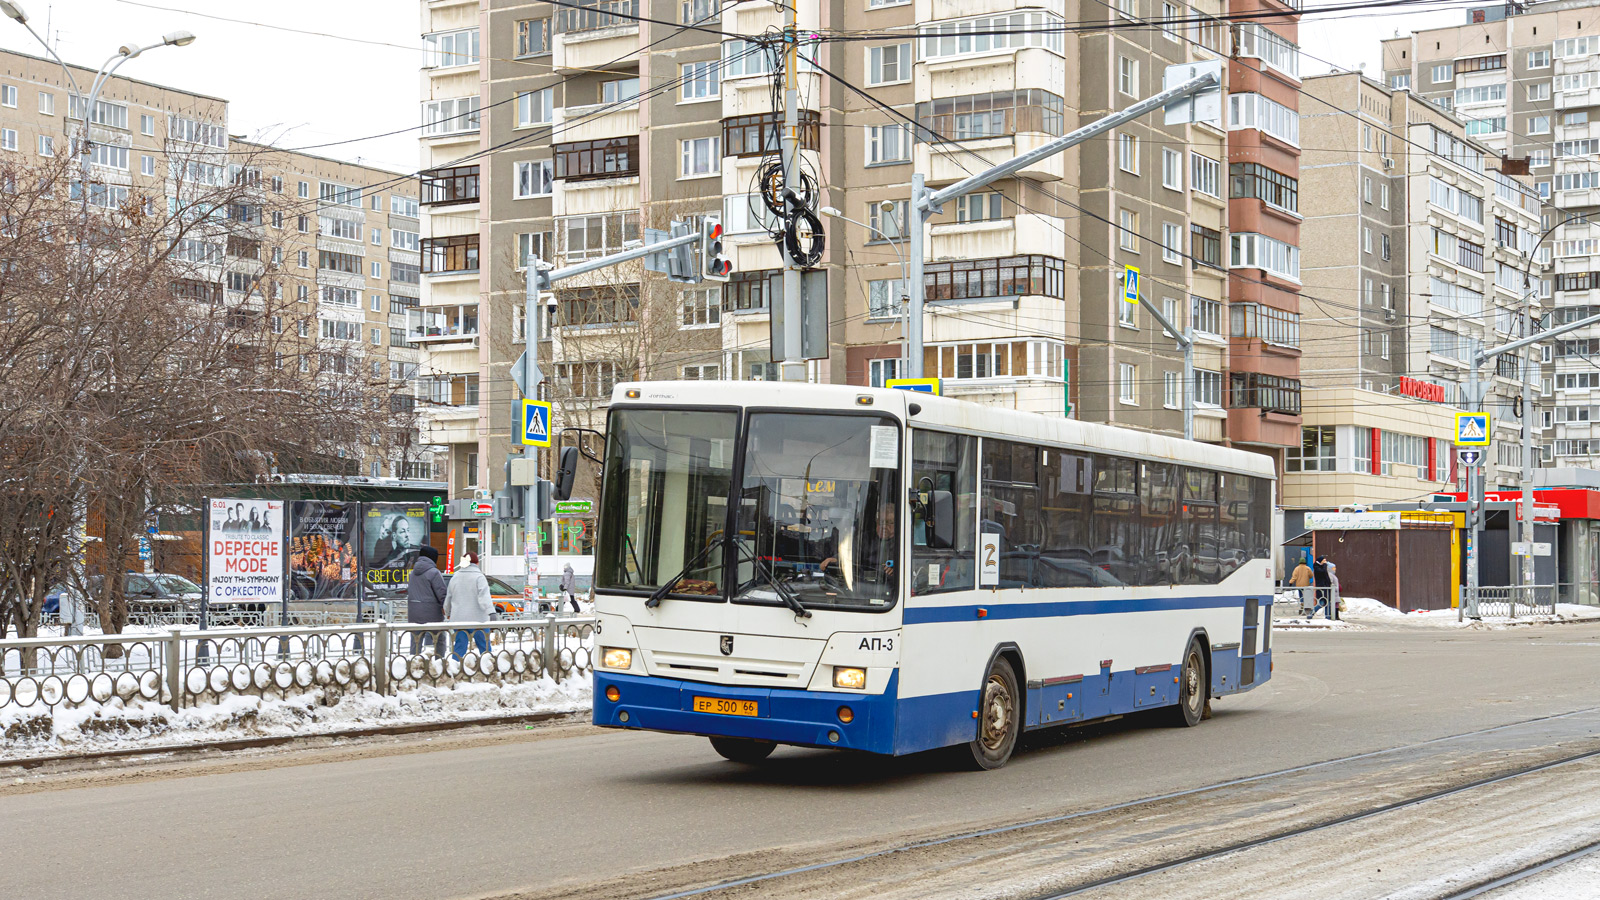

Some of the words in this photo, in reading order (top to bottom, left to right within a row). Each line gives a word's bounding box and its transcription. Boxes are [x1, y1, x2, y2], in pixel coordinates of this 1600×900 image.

[214, 541, 278, 556] DEPECHE
[225, 558, 268, 573] MODE
[366, 569, 391, 583] СВЕТ
[392, 569, 401, 583] С
[215, 586, 223, 597] С
[225, 586, 277, 597] ОРКЕСТРОМ
[858, 637, 894, 651] АП-3
[717, 700, 738, 713] 500
[743, 702, 754, 712] 66
